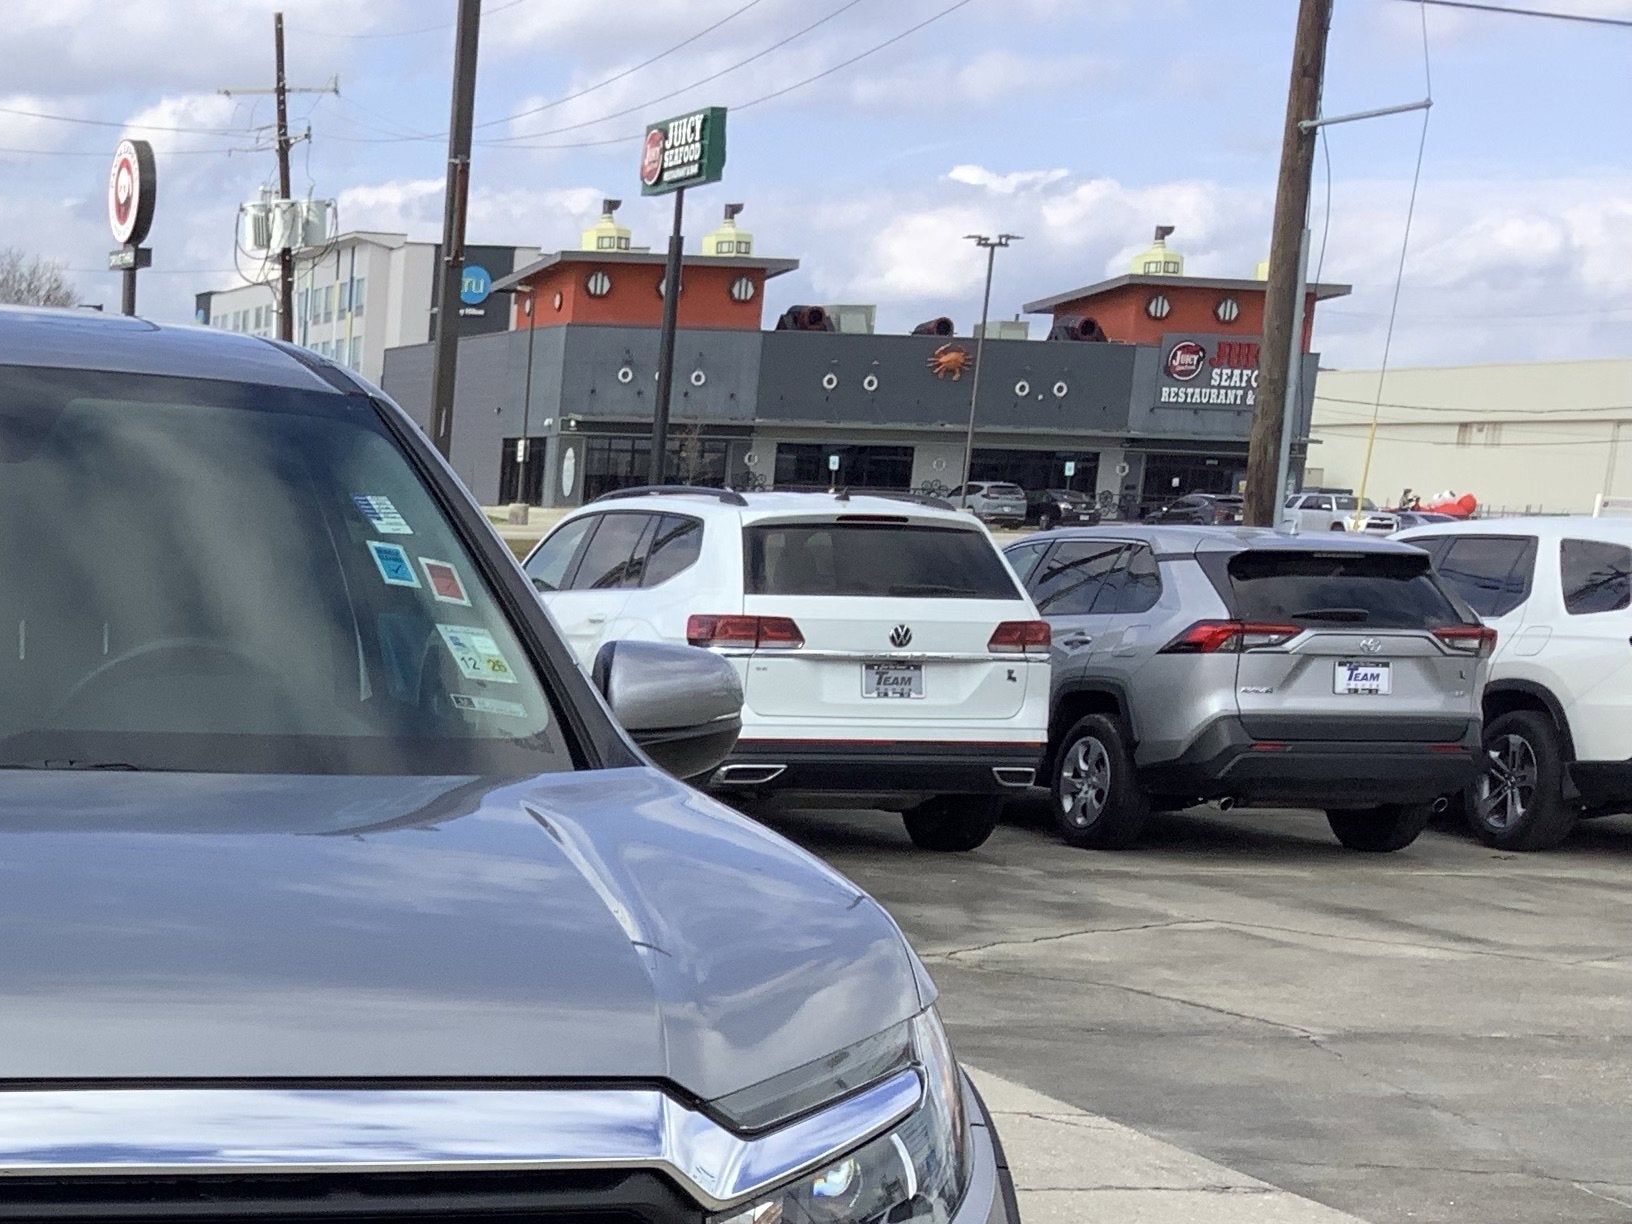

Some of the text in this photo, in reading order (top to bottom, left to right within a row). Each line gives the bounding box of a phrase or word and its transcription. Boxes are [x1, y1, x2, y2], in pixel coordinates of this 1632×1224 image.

[664, 114, 704, 149] JUICY
[663, 142, 702, 168] SEAFOOD
[462, 277, 485, 293] ru
[1210, 368, 1259, 388] SEAFO
[1161, 387, 1244, 404] RESTAURANT
[460, 656, 481, 671] 12
[1347, 667, 1381, 681] TEAM
